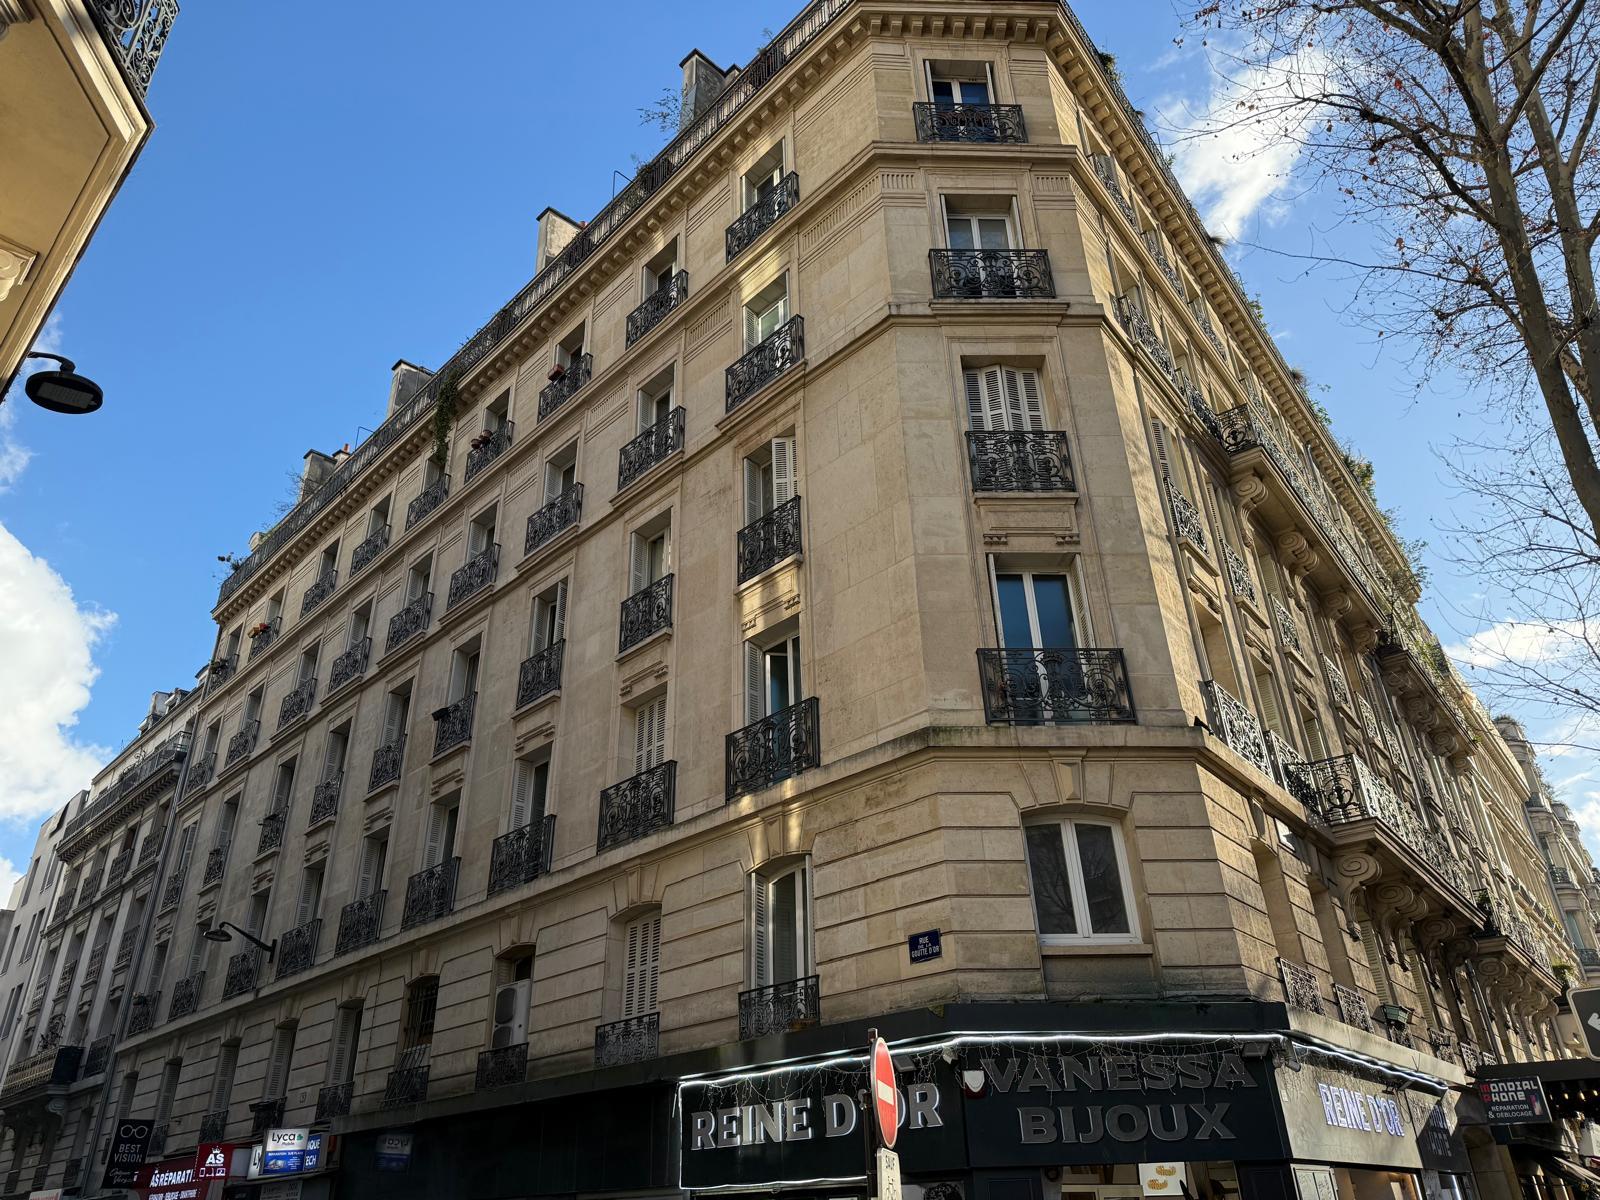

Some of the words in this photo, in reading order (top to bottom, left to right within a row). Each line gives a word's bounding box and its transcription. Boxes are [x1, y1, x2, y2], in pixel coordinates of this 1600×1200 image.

[912, 948, 928, 958] GOUTTE
[980, 1053, 1258, 1093] VANESSA
[1318, 1083, 1371, 1132] REINE
[1366, 1094, 1405, 1137] D'OR
[1488, 1110, 1495, 1118] &
[691, 1097, 814, 1151] REINE
[1017, 1102, 1237, 1144] BIJOUX
[271, 1132, 296, 1144] Lyca
[119, 1143, 142, 1153] BEST
[114, 1153, 143, 1163] VISION
[205, 1153, 225, 1164] AS
